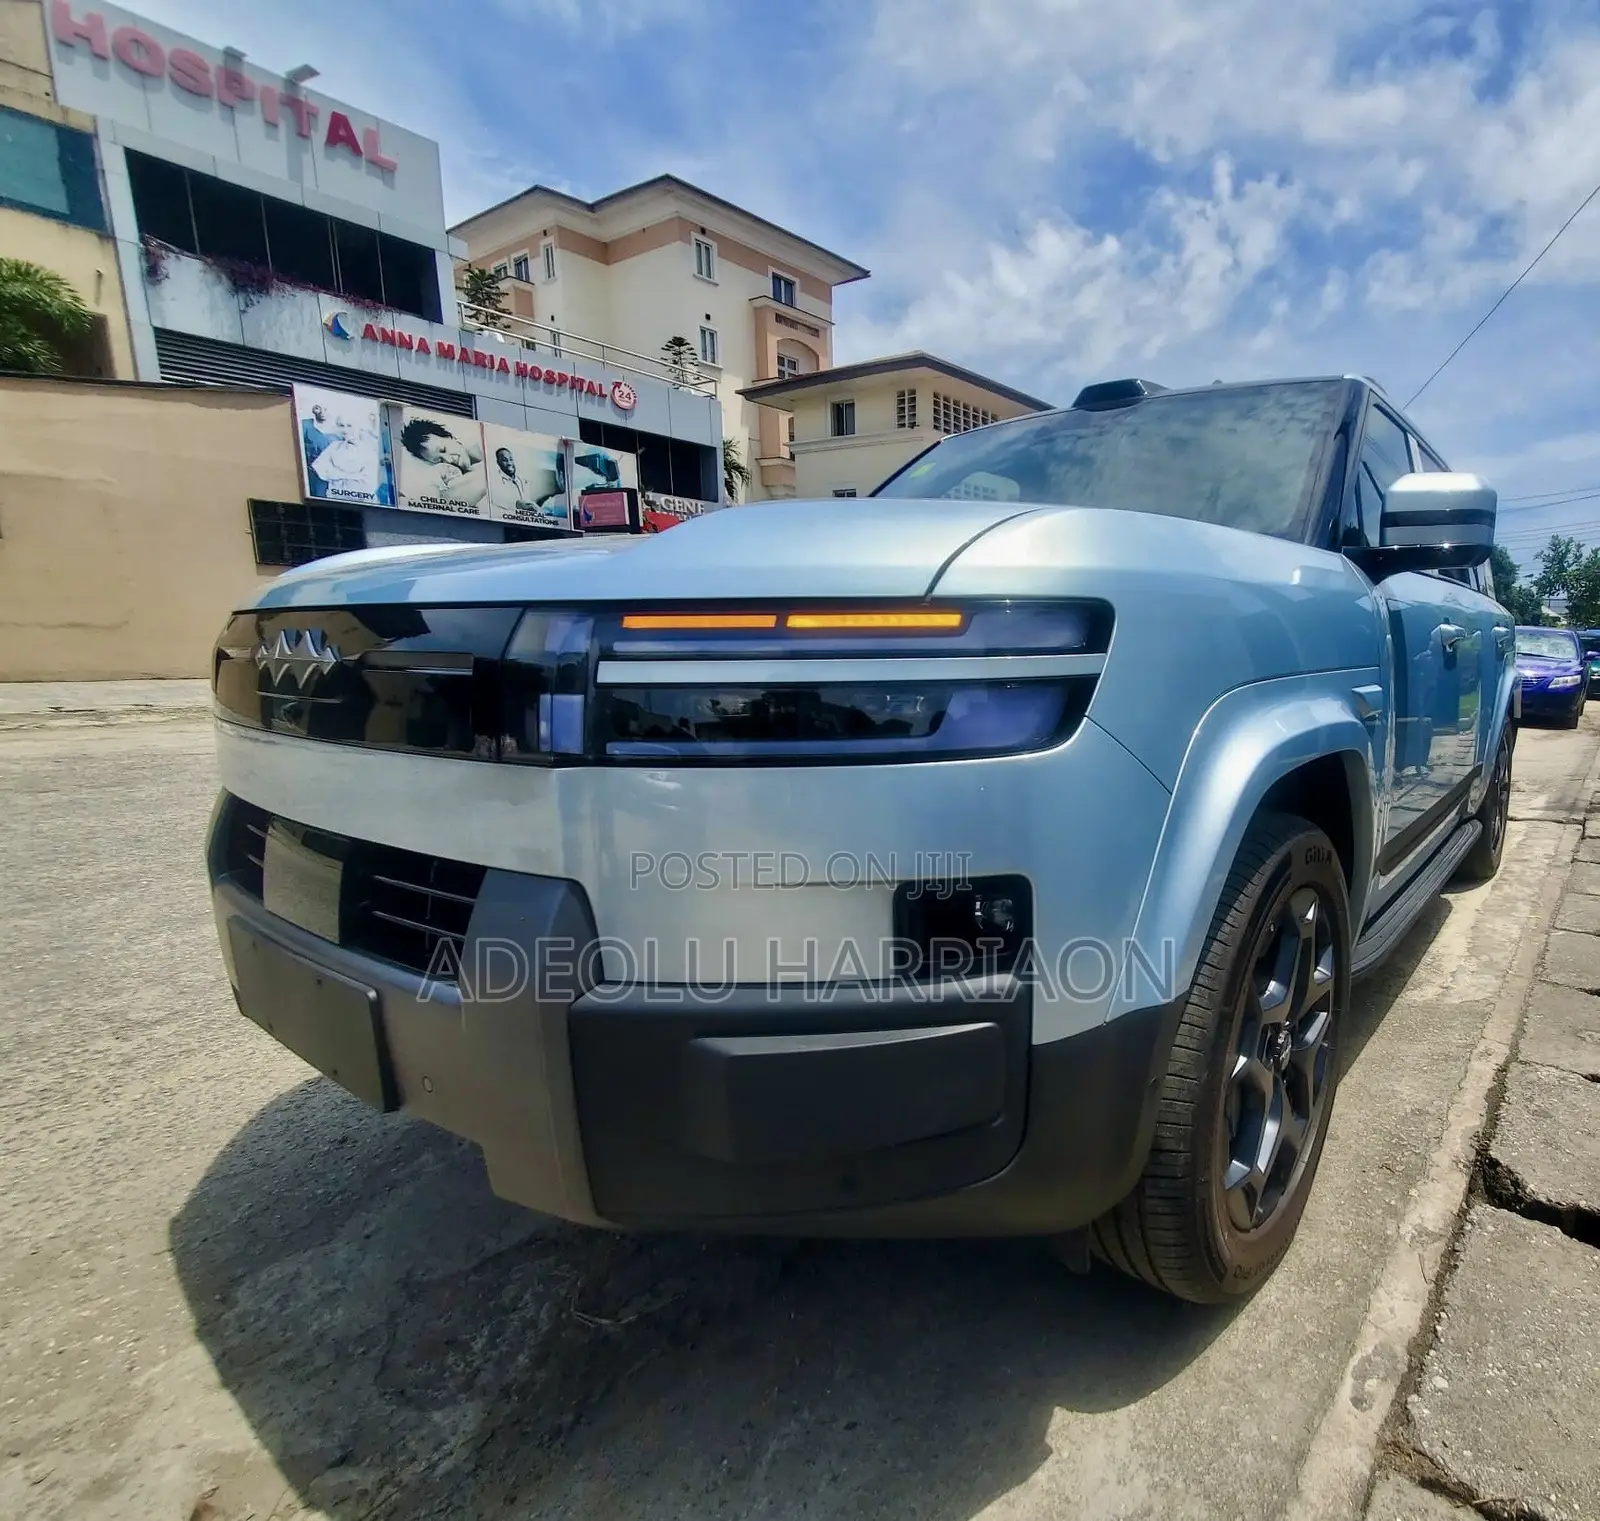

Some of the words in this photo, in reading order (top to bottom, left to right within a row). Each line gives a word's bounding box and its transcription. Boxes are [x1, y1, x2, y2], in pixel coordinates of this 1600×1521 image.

[51, 0, 398, 173] HOSPITAL
[361, 323, 431, 354] ANNA
[436, 341, 510, 374] MARIA
[513, 360, 608, 398] HOSPITAL
[618, 389, 632, 401] 24
[331, 488, 376, 500] SURGERY
[408, 501, 456, 512] MATERNAL
[420, 496, 447, 505] CHILD
[502, 514, 560, 526] CONSULTATIONS
[515, 510, 546, 518] MEDICAL
